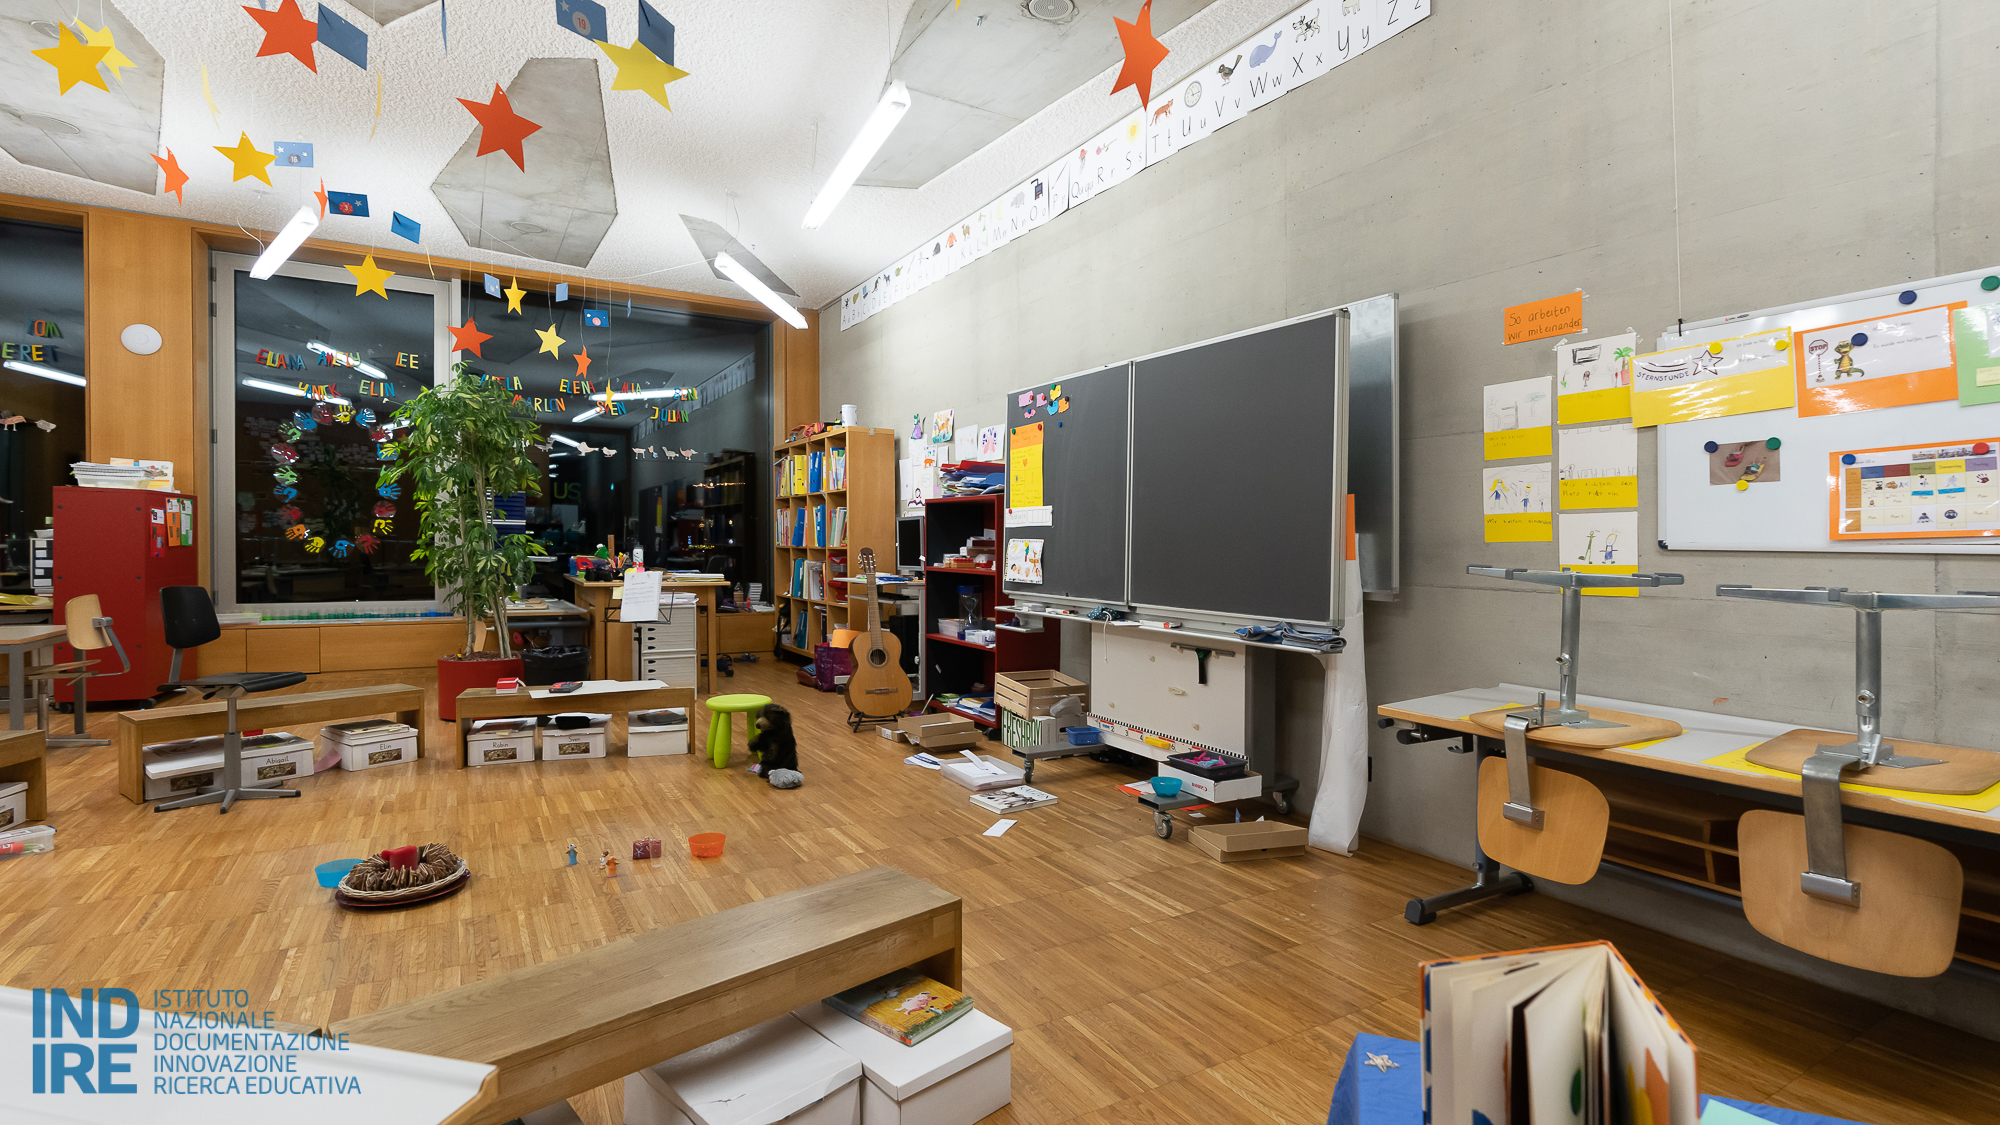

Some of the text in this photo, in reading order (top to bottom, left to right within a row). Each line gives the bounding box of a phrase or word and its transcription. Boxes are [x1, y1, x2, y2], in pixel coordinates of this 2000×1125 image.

[577, 17, 586, 30] 19
[1508, 305, 1571, 327] So arbeiten
[27, 318, 62, 338] TOM
[1528, 318, 1581, 337] miteinander
[1810, 343, 1827, 351] STOP
[317, 350, 361, 367] AMELY
[395, 352, 418, 369] LEE
[1636, 370, 1689, 382] STERNSTUNDE
[359, 379, 395, 397] ELIN
[560, 379, 596, 394] ELENA
[620, 382, 642, 395] MIA
[650, 406, 689, 423] JULIAN
[266, 756, 289, 765] Abigail
